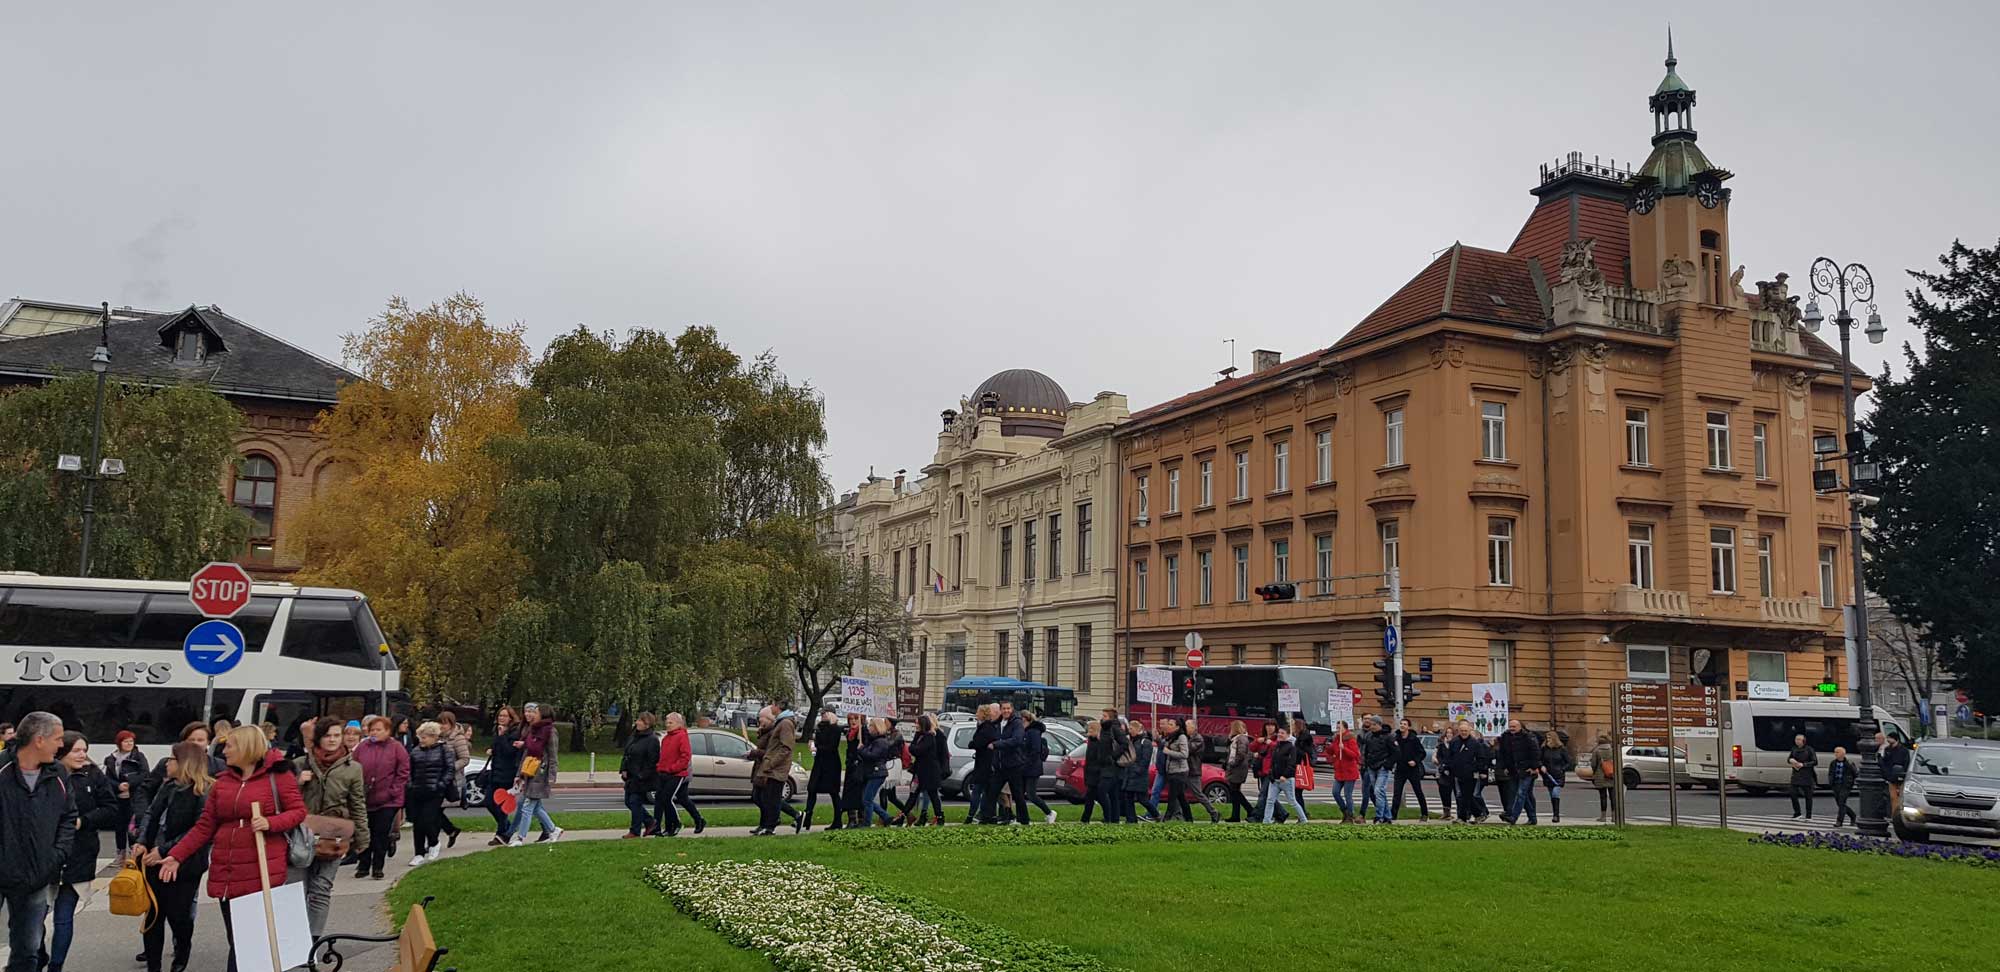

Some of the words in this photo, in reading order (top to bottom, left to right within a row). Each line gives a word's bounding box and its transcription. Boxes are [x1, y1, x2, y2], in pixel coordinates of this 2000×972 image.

[195, 578, 247, 602] STOP
[14, 650, 173, 684] Tours
[1138, 680, 1173, 694] RESISTANCE
[1153, 692, 1171, 703] DUTY
